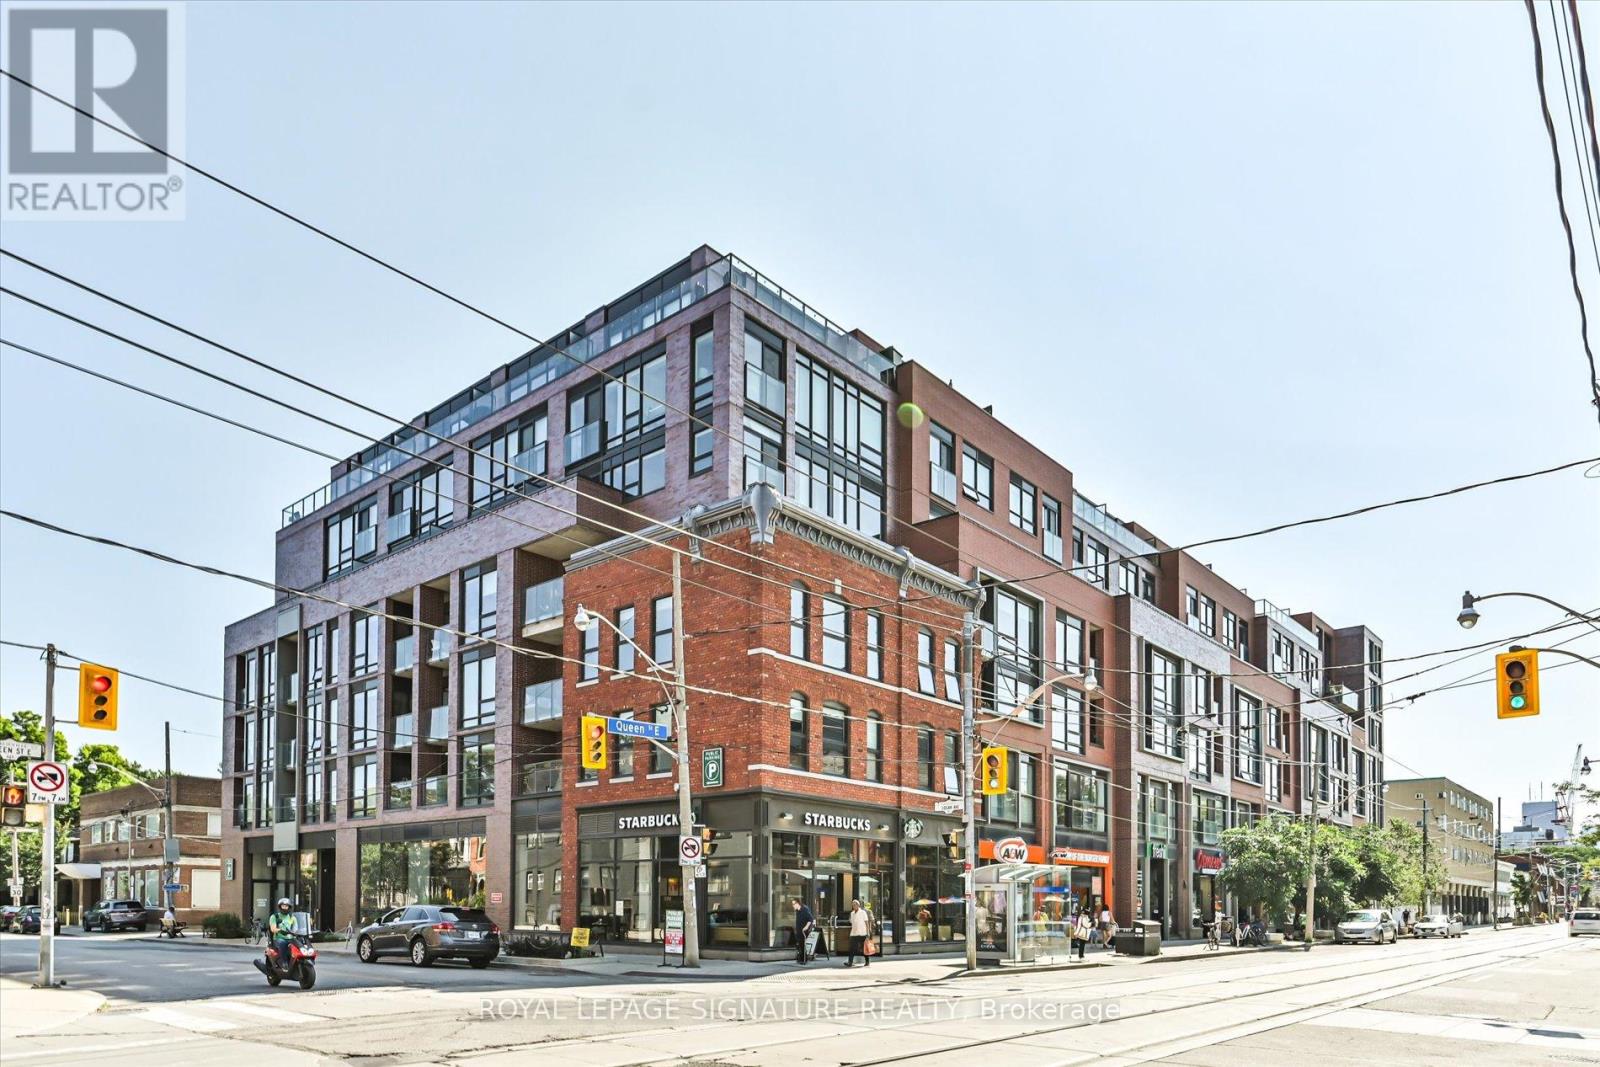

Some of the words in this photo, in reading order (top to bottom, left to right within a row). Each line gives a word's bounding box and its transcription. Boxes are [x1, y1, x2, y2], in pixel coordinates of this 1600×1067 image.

[615, 720, 645, 734] Queen
[654, 726, 660, 736] E
[708, 763, 717, 779] P
[618, 813, 681, 830] STARBUCK
[804, 812, 871, 832] STARBUCKS
[1002, 847, 1026, 860] A&W
